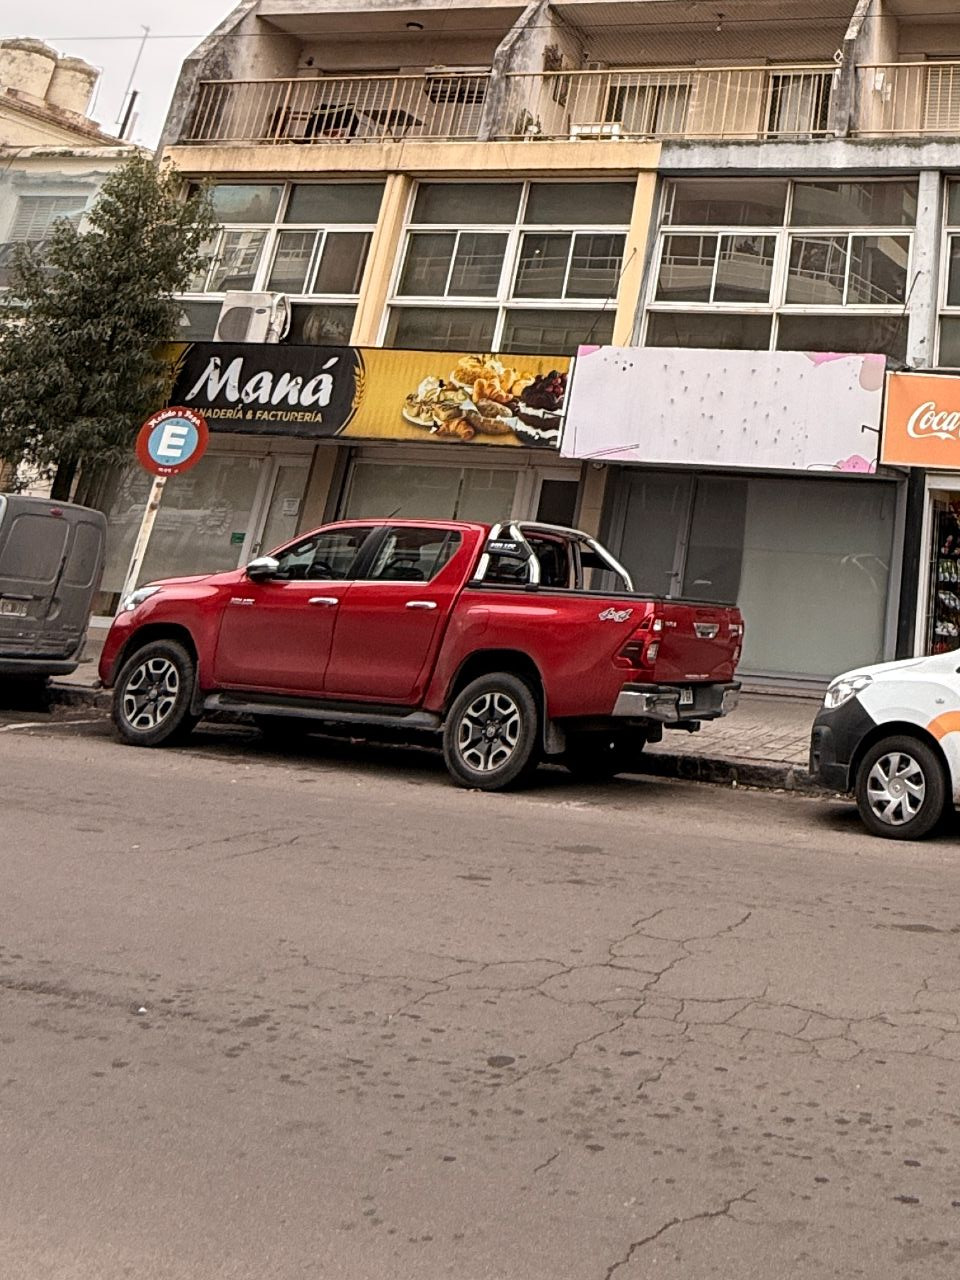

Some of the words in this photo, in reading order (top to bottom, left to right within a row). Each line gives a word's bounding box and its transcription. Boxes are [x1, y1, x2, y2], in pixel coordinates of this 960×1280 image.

[185, 356, 339, 406] Maná
[191, 406, 242, 419] NADERÍA
[245, 409, 253, 420] &
[157, 424, 189, 457] E
